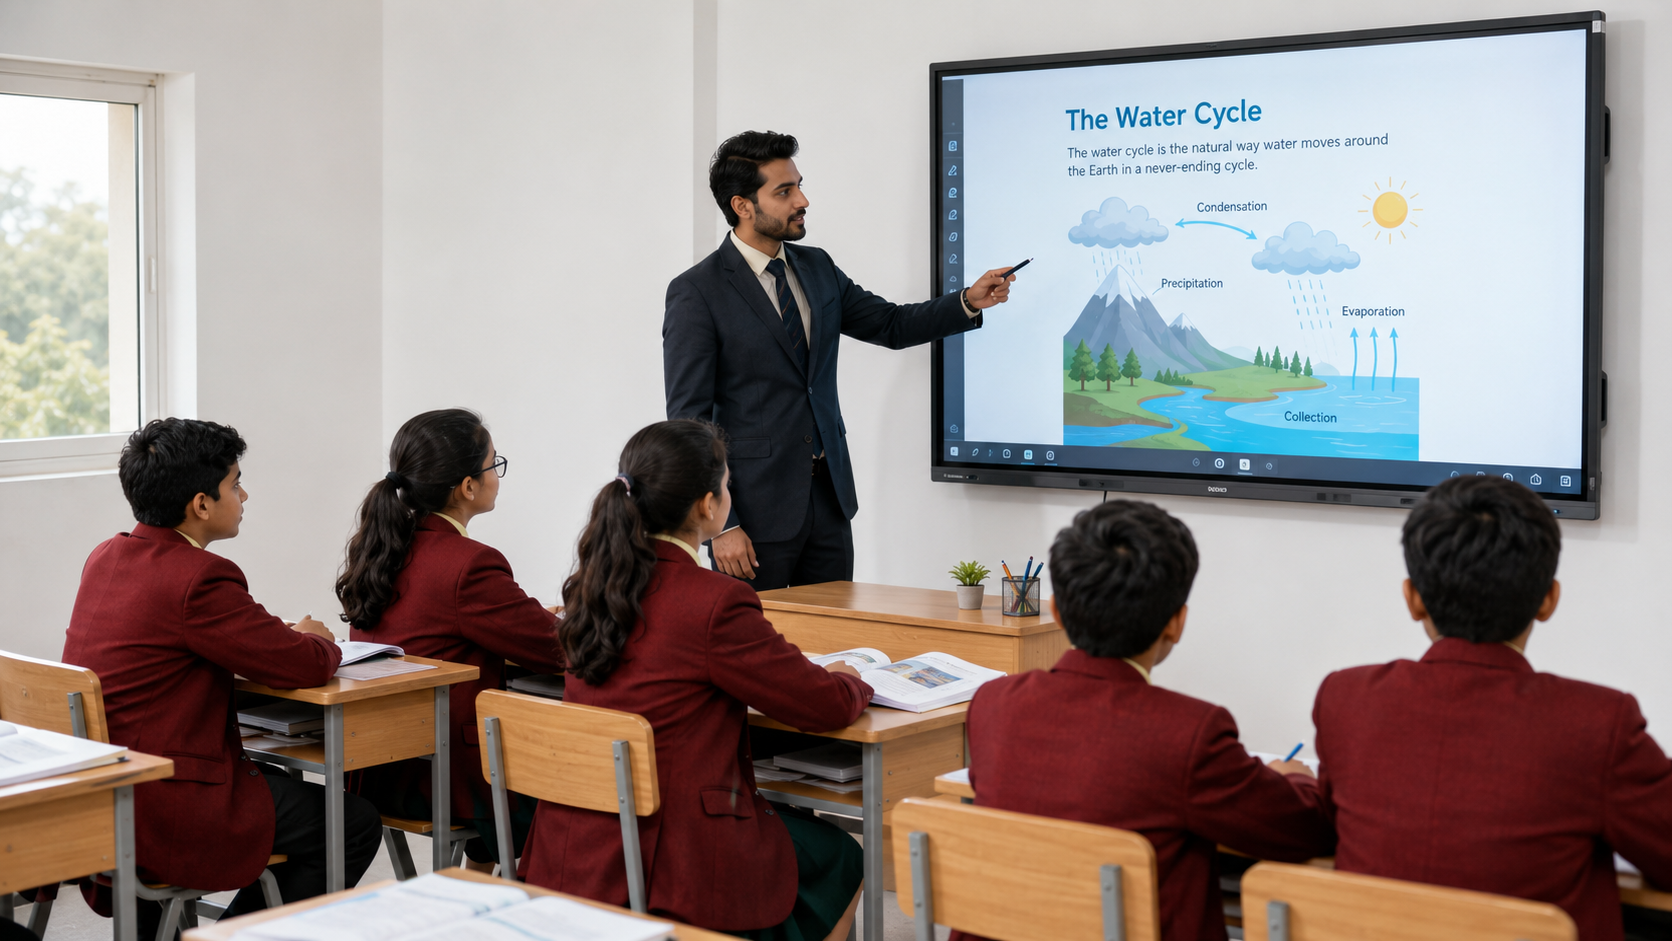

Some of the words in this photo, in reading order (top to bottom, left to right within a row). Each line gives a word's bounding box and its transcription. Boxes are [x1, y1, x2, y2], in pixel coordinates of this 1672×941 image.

[1065, 108, 1109, 131] The
[1115, 105, 1187, 129] Water
[1194, 98, 1262, 130] Cycle
[1067, 147, 1088, 159] The
[1090, 146, 1123, 158] water
[1125, 143, 1154, 159] cycle
[1157, 143, 1167, 155] is
[1169, 142, 1189, 155] the
[1192, 139, 1232, 154] natural
[1235, 142, 1260, 154] way
[1263, 138, 1298, 150] water
[1301, 138, 1341, 149] moves
[1344, 132, 1389, 147] around
[1067, 165, 1086, 177] the
[1089, 163, 1118, 176] Earth
[1121, 163, 1132, 175] in
[1134, 165, 1142, 175] a
[1145, 159, 1221, 175] never-ending
[1224, 158, 1258, 174] cycle.
[1196, 200, 1268, 213] Condensation
[1161, 277, 1223, 291] Precipitation
[1342, 305, 1405, 319] Evaporation
[1284, 410, 1338, 423] Collection
